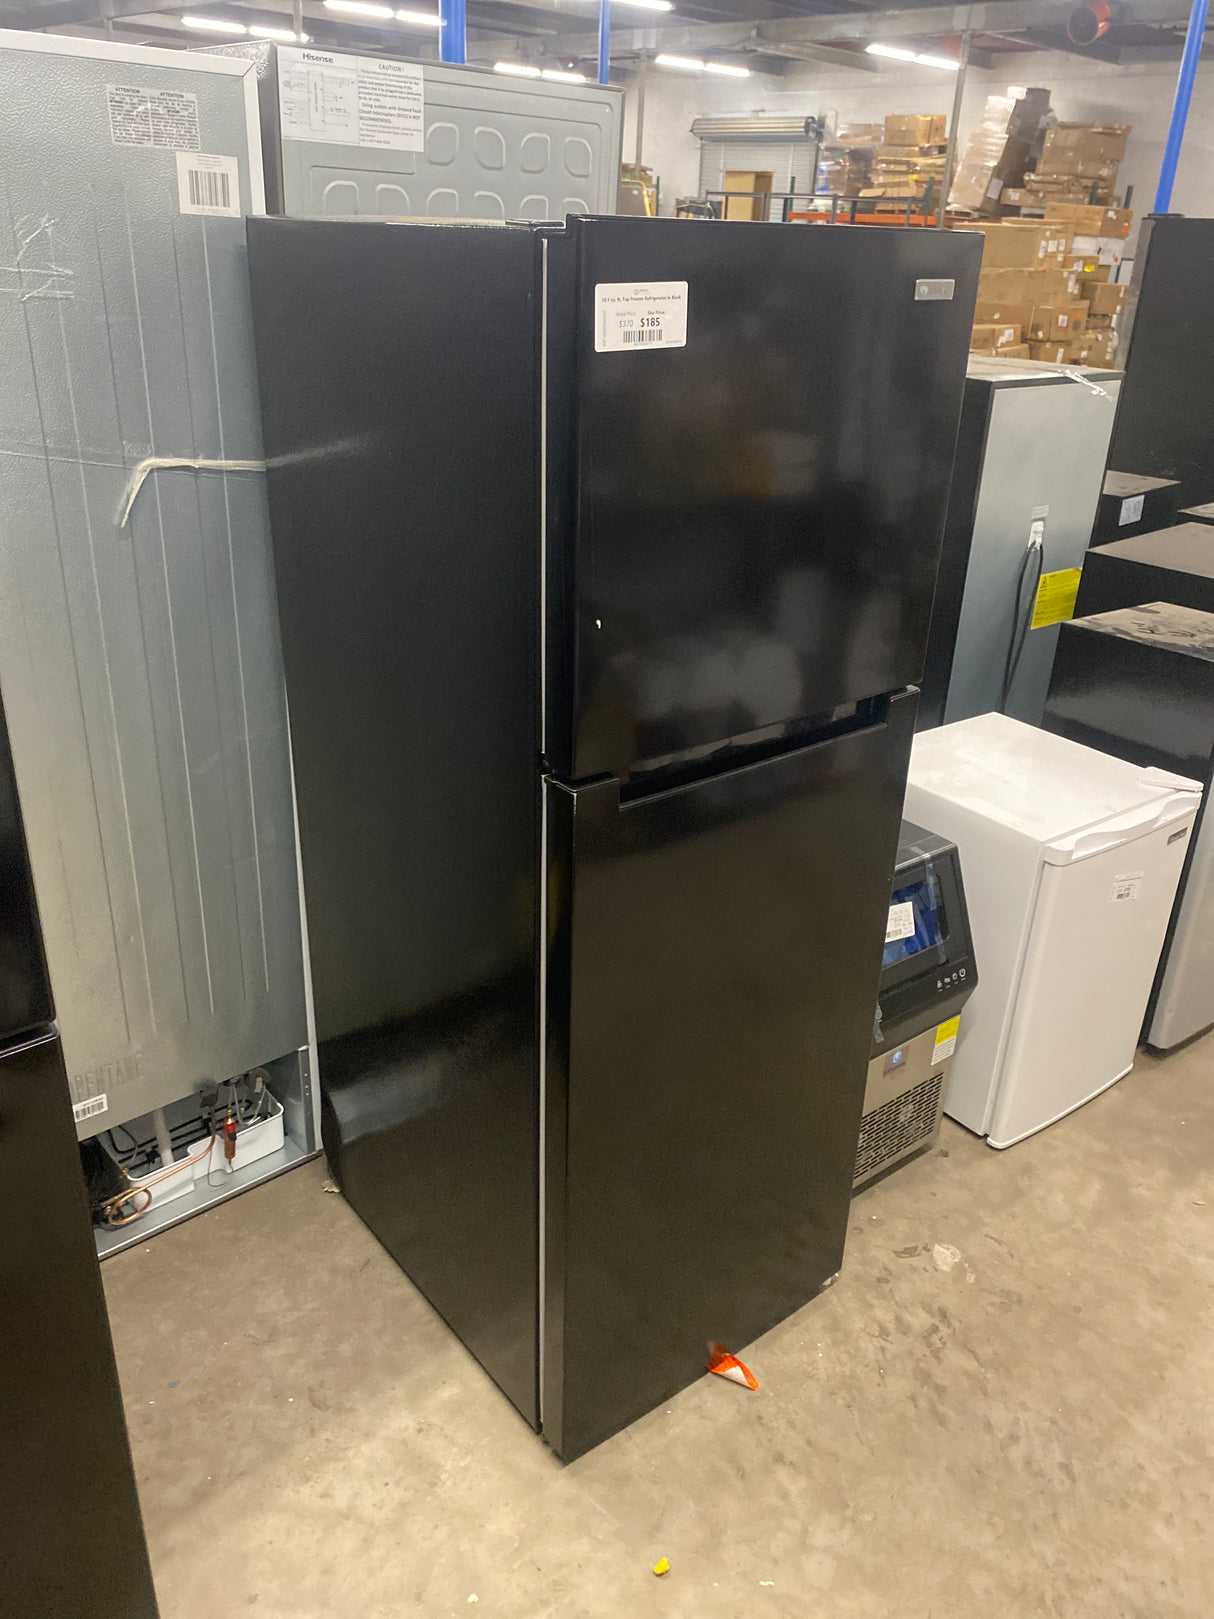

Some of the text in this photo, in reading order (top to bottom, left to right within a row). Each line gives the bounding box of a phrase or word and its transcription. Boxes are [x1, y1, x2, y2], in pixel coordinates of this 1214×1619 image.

[302, 52, 334, 63] Hisense
[619, 320, 634, 328] $370
[640, 317, 660, 327] $185
